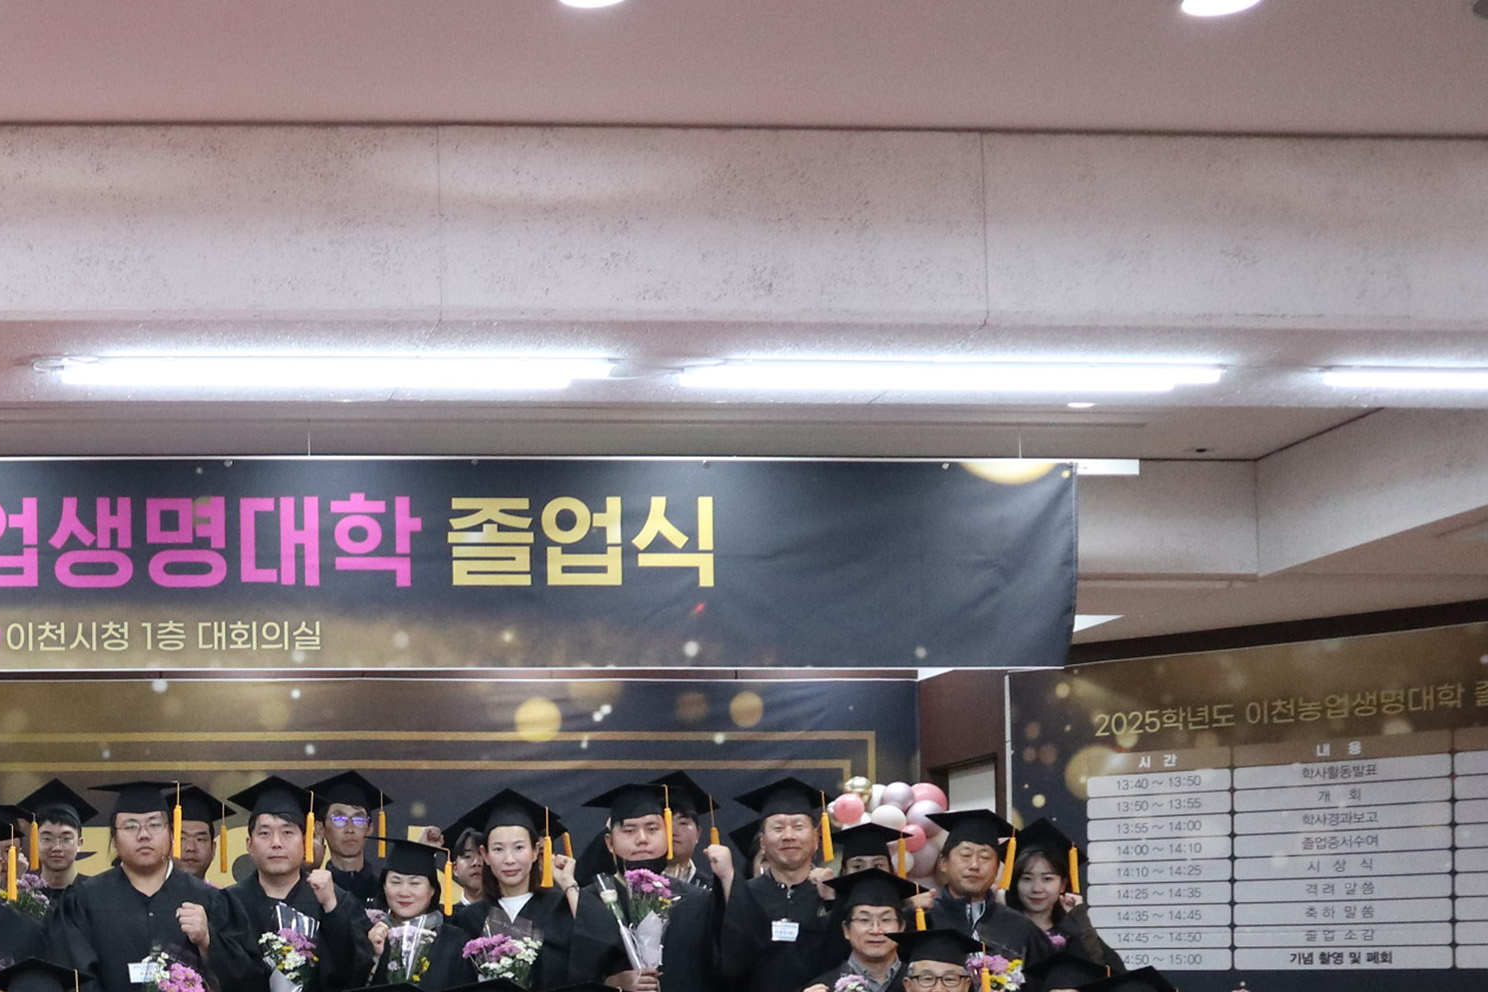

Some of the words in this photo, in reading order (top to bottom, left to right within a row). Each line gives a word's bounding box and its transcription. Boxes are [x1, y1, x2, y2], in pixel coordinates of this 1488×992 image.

[447, 496, 714, 587] 졸업식
[6, 621, 130, 652] 이천시청
[141, 621, 186, 651] 1층
[198, 620, 322, 651] 대회의실
[1095, 703, 1236, 737] 2025학년도
[1245, 683, 1466, 725] 이천농업생명대학
[1116, 778, 1149, 790] 13:40
[1168, 775, 1202, 788] 13:50
[1116, 800, 1149, 813] 13:50
[1168, 797, 1202, 810] 13:55
[1116, 822, 1149, 834] 13:55
[1168, 820, 1202, 832] 14:00
[1116, 844, 1149, 856] 14:00
[1168, 842, 1202, 854] 14:10
[1117, 866, 1149, 878] 14:10
[1168, 864, 1202, 876] 14:25
[1117, 888, 1149, 900] 14:25
[1168, 887, 1202, 899] 14:35
[1117, 910, 1149, 922] 14:35
[1168, 909, 1202, 921] 14:45
[1117, 932, 1149, 944] 14:45
[1168, 931, 1202, 943] 14:50
[1123, 955, 1150, 965] 4:50
[1168, 954, 1202, 965] 15:00
[1290, 952, 1314, 966] 기념
[1349, 952, 1361, 965] 및
